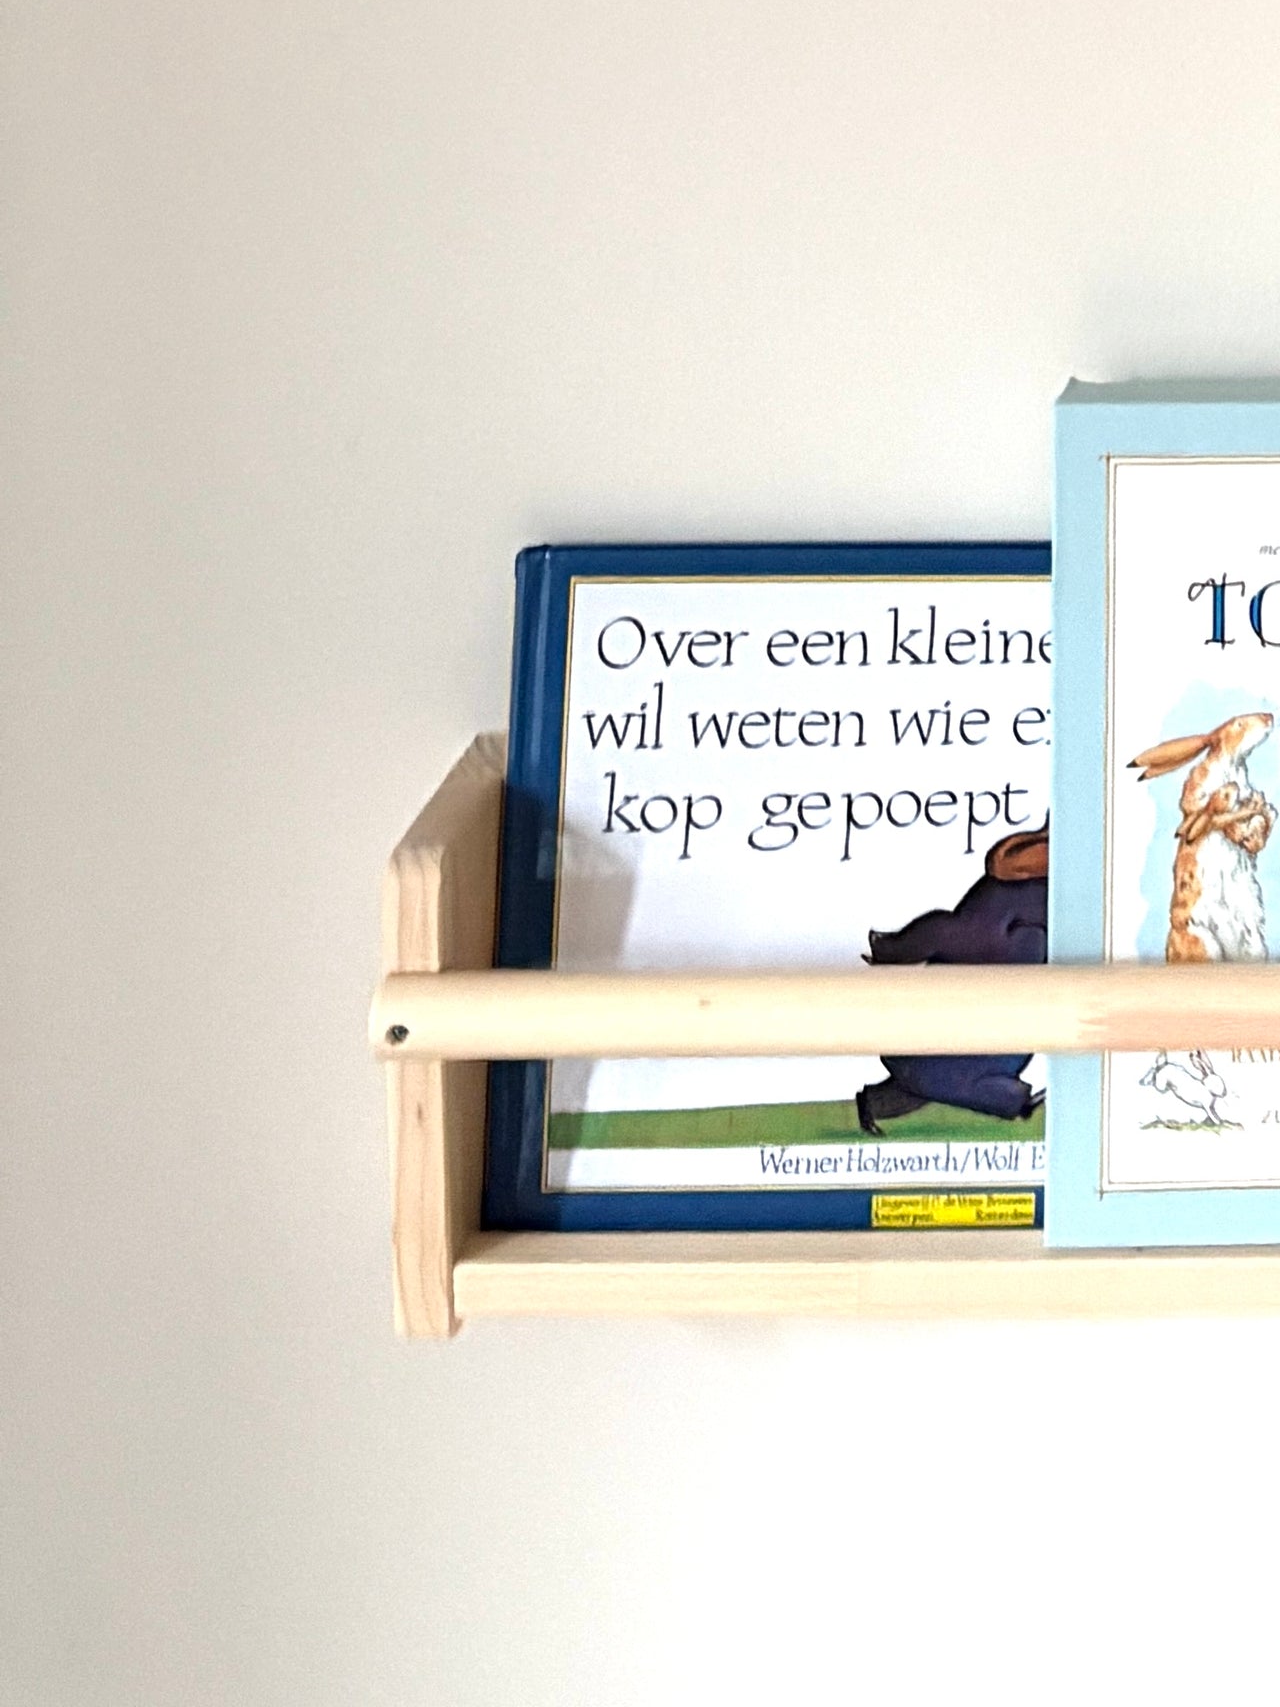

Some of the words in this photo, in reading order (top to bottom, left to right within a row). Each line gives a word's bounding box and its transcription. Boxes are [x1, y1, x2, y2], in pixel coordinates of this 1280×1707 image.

[597, 616, 750, 670] Over
[766, 629, 870, 667] een
[582, 681, 664, 750] wil
[688, 707, 867, 749] weten
[890, 700, 991, 746] wie
[601, 771, 723, 860] kop
[747, 782, 1030, 861] gepoept
[759, 1145, 843, 1175] Werner
